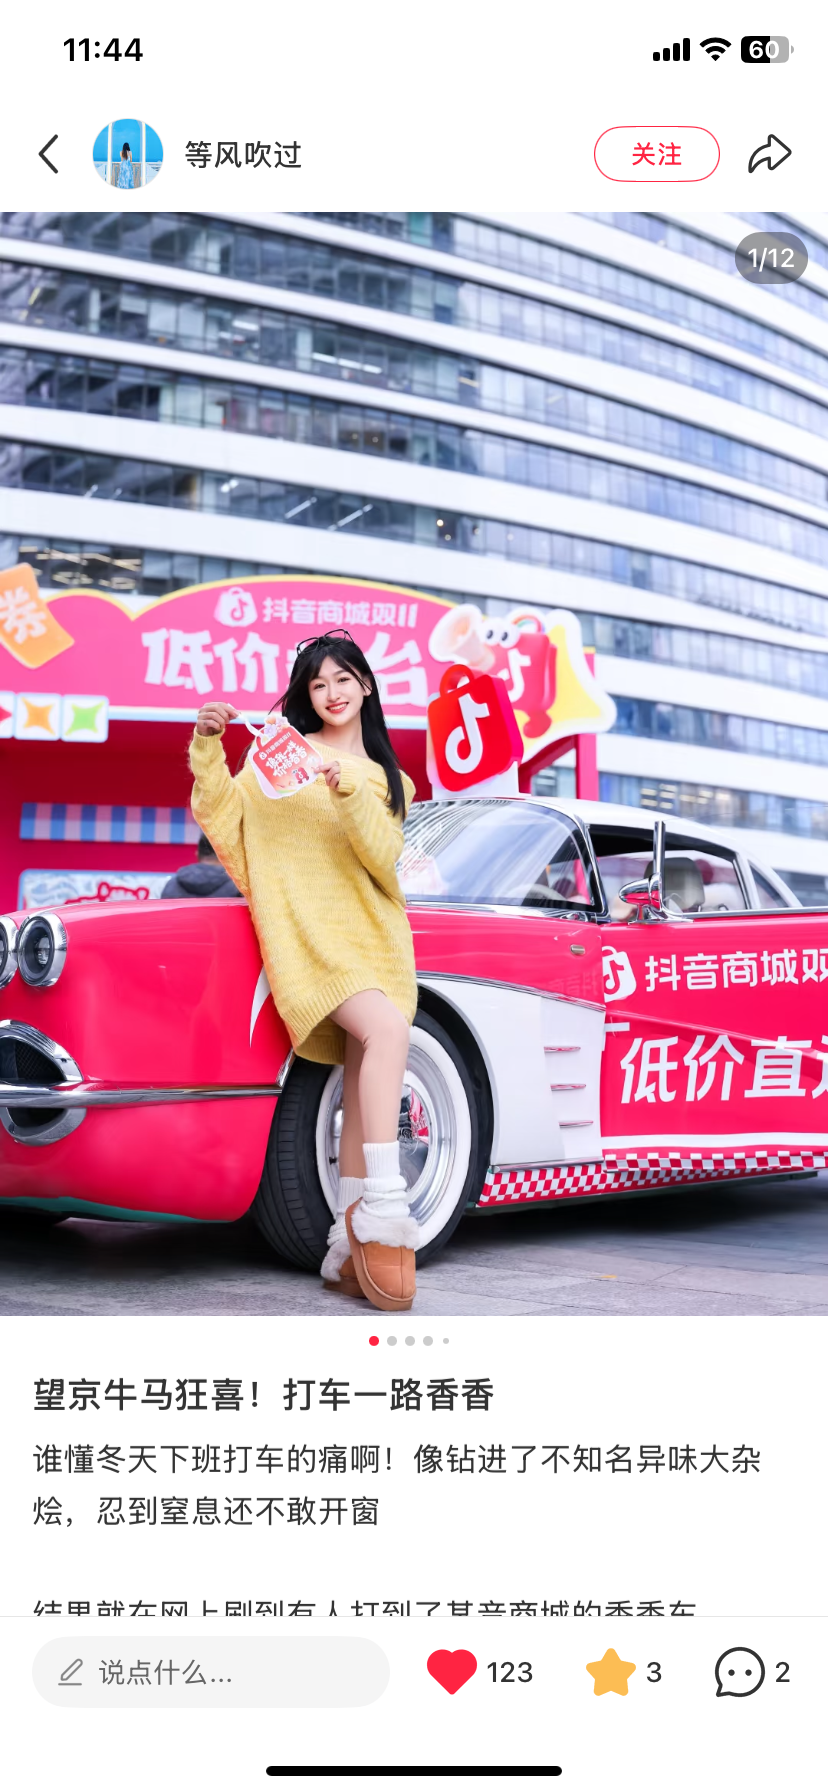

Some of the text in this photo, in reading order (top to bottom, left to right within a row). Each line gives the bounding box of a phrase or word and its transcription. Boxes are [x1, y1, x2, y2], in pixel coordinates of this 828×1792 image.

[64, 38, 143, 62] 11:44
[749, 40, 779, 59] 60
[185, 140, 302, 169] 等风吹过
[632, 141, 682, 167] 关注
[262, 597, 418, 628] 抖音商城双11
[141, 628, 428, 707] 低价台
[645, 948, 828, 992] 抖音商城双
[620, 1034, 828, 1104] 低价直
[34, 1377, 494, 1412] 望京牛马狂喜！打车一路香香
[33, 1444, 761, 1474] 谁懂冬天下班打车的痛啊！像钻进了不知名异味大杂
[33, 1496, 379, 1528] 烩，忍到窒息还不敢开窗
[488, 1662, 533, 1683] 123
[646, 1662, 662, 1683] 3
[775, 1662, 791, 1683] 2
